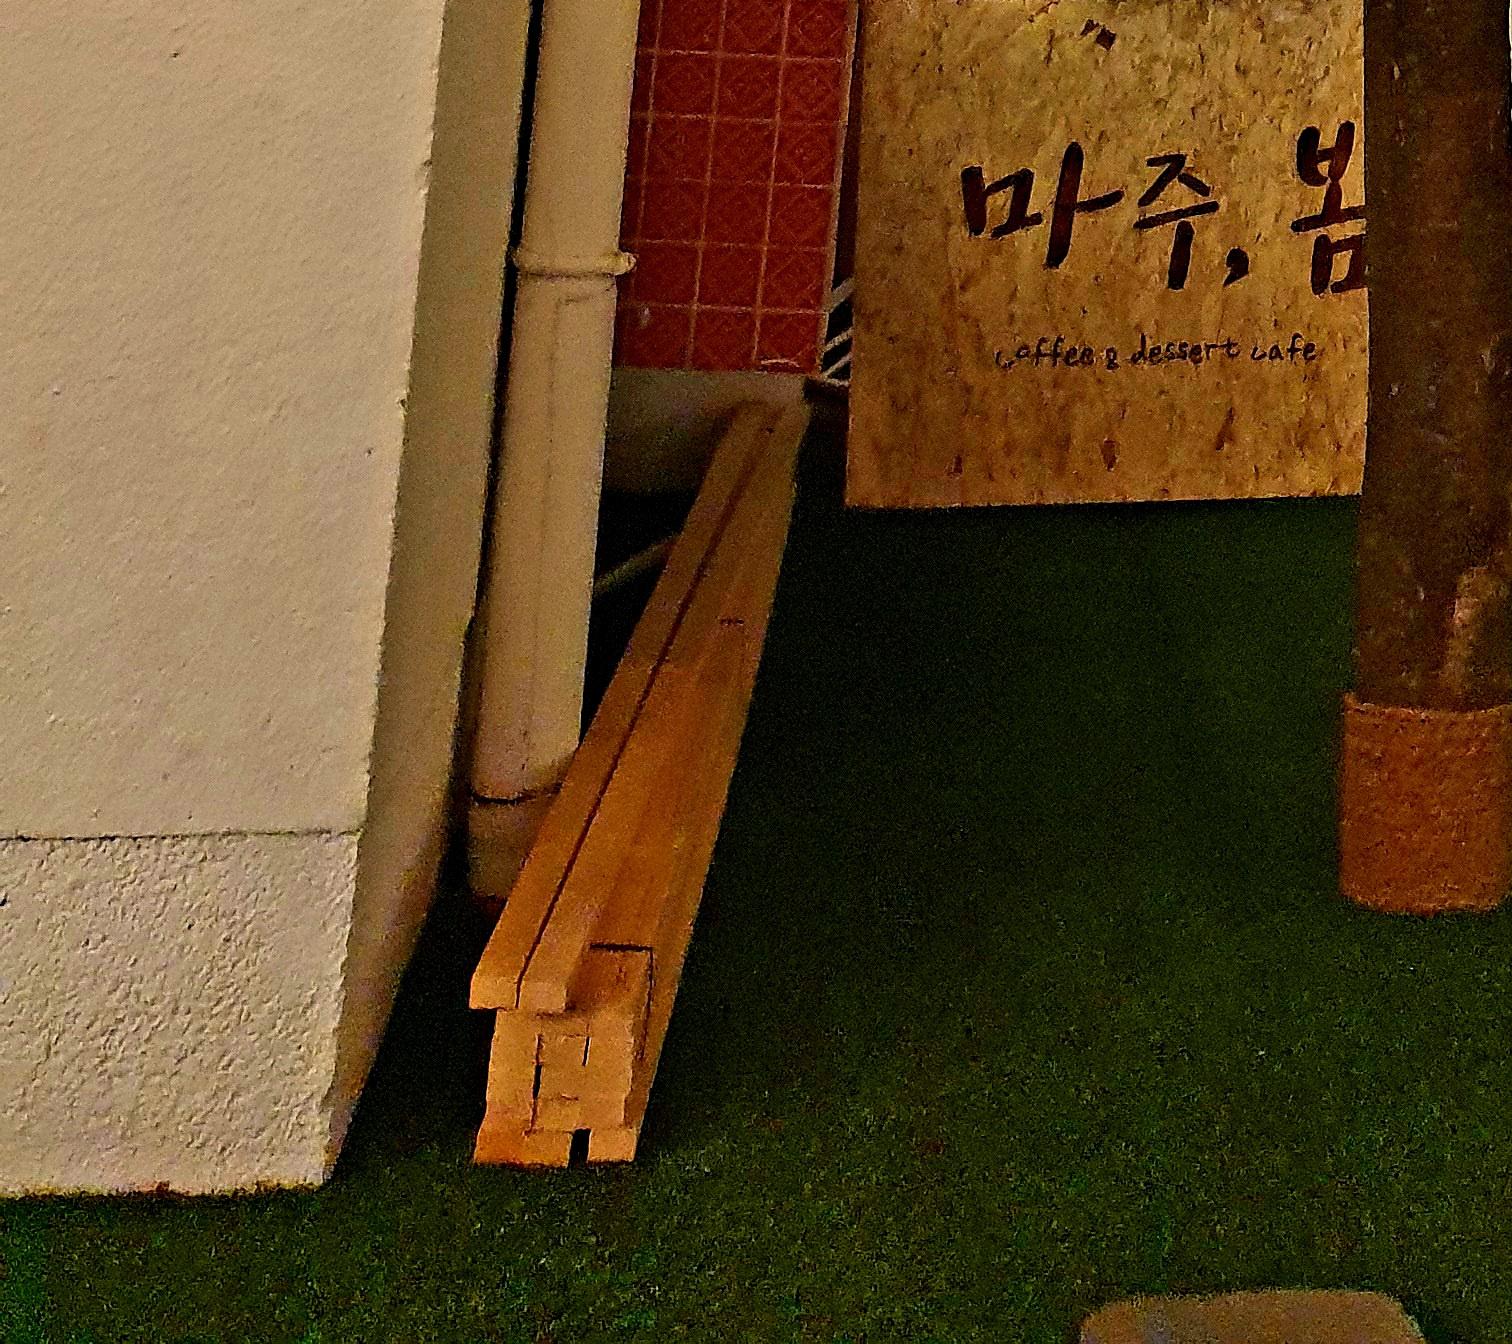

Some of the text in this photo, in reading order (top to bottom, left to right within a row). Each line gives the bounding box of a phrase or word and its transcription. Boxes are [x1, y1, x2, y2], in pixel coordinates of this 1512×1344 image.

[961, 120, 1369, 297] 마주, 봄
[1130, 332, 1240, 364] dessert
[1250, 332, 1317, 362] cafe
